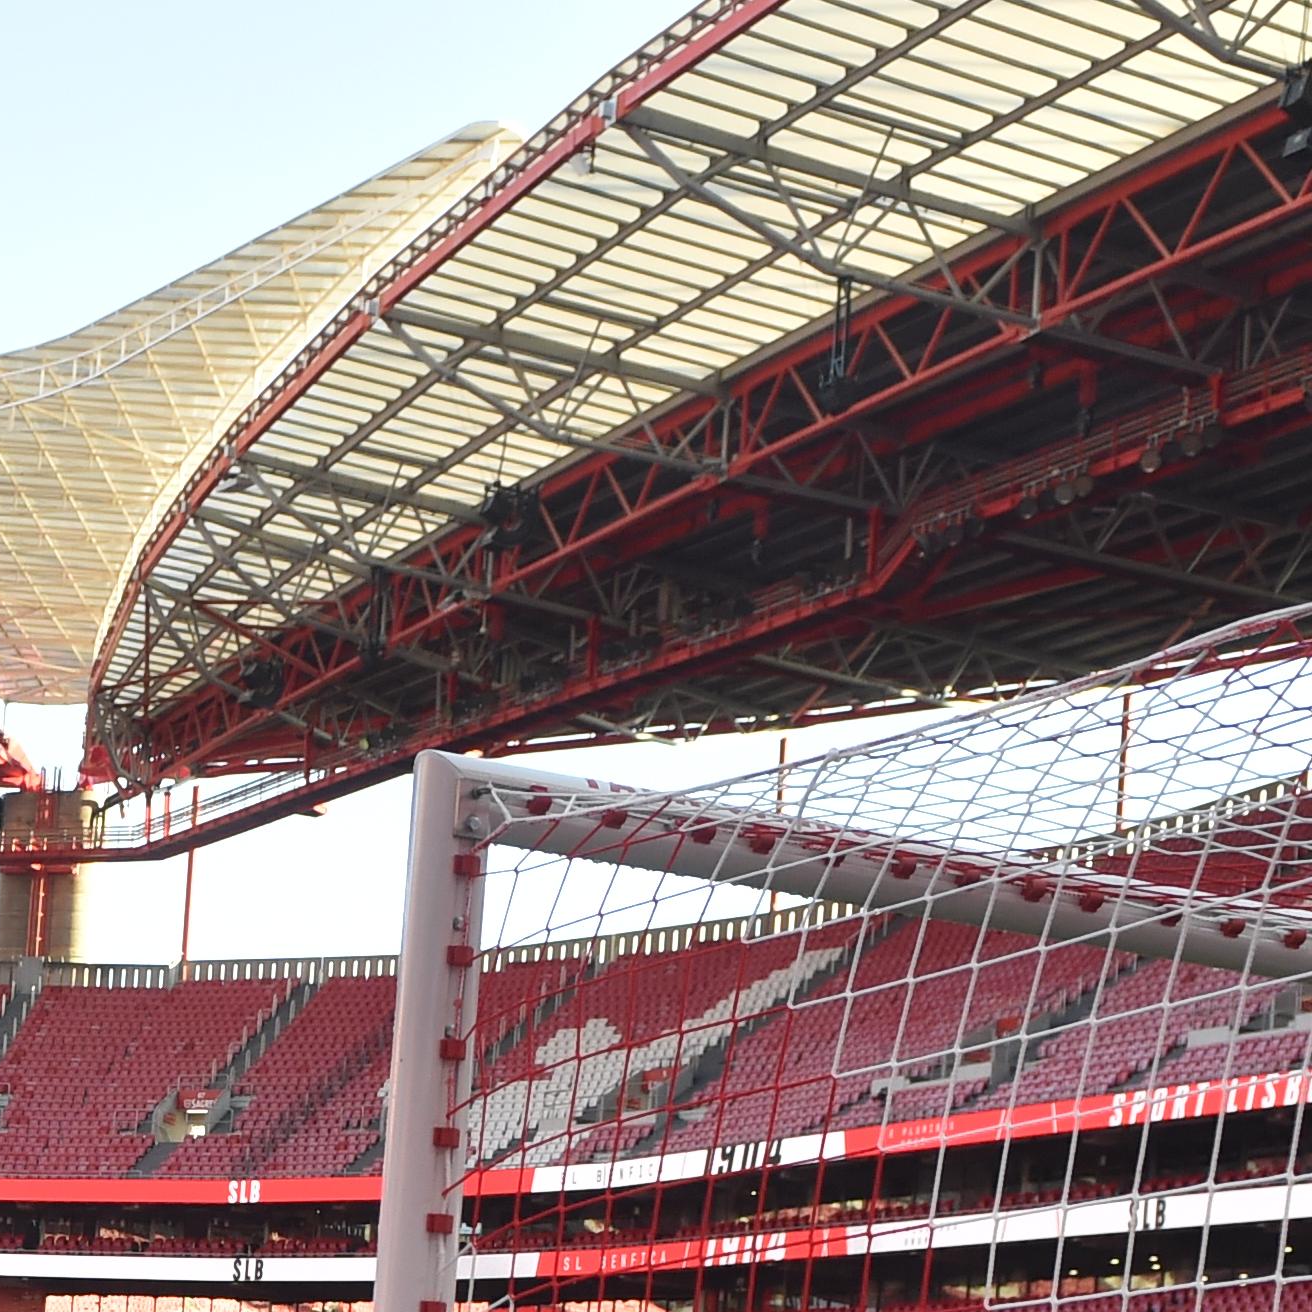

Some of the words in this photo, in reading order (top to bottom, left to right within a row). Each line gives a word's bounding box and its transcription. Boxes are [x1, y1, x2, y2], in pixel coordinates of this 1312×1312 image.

[1108, 1081, 1211, 1128] SPORT
[227, 1179, 261, 1204] SLB
[233, 1258, 265, 1282] SLB
